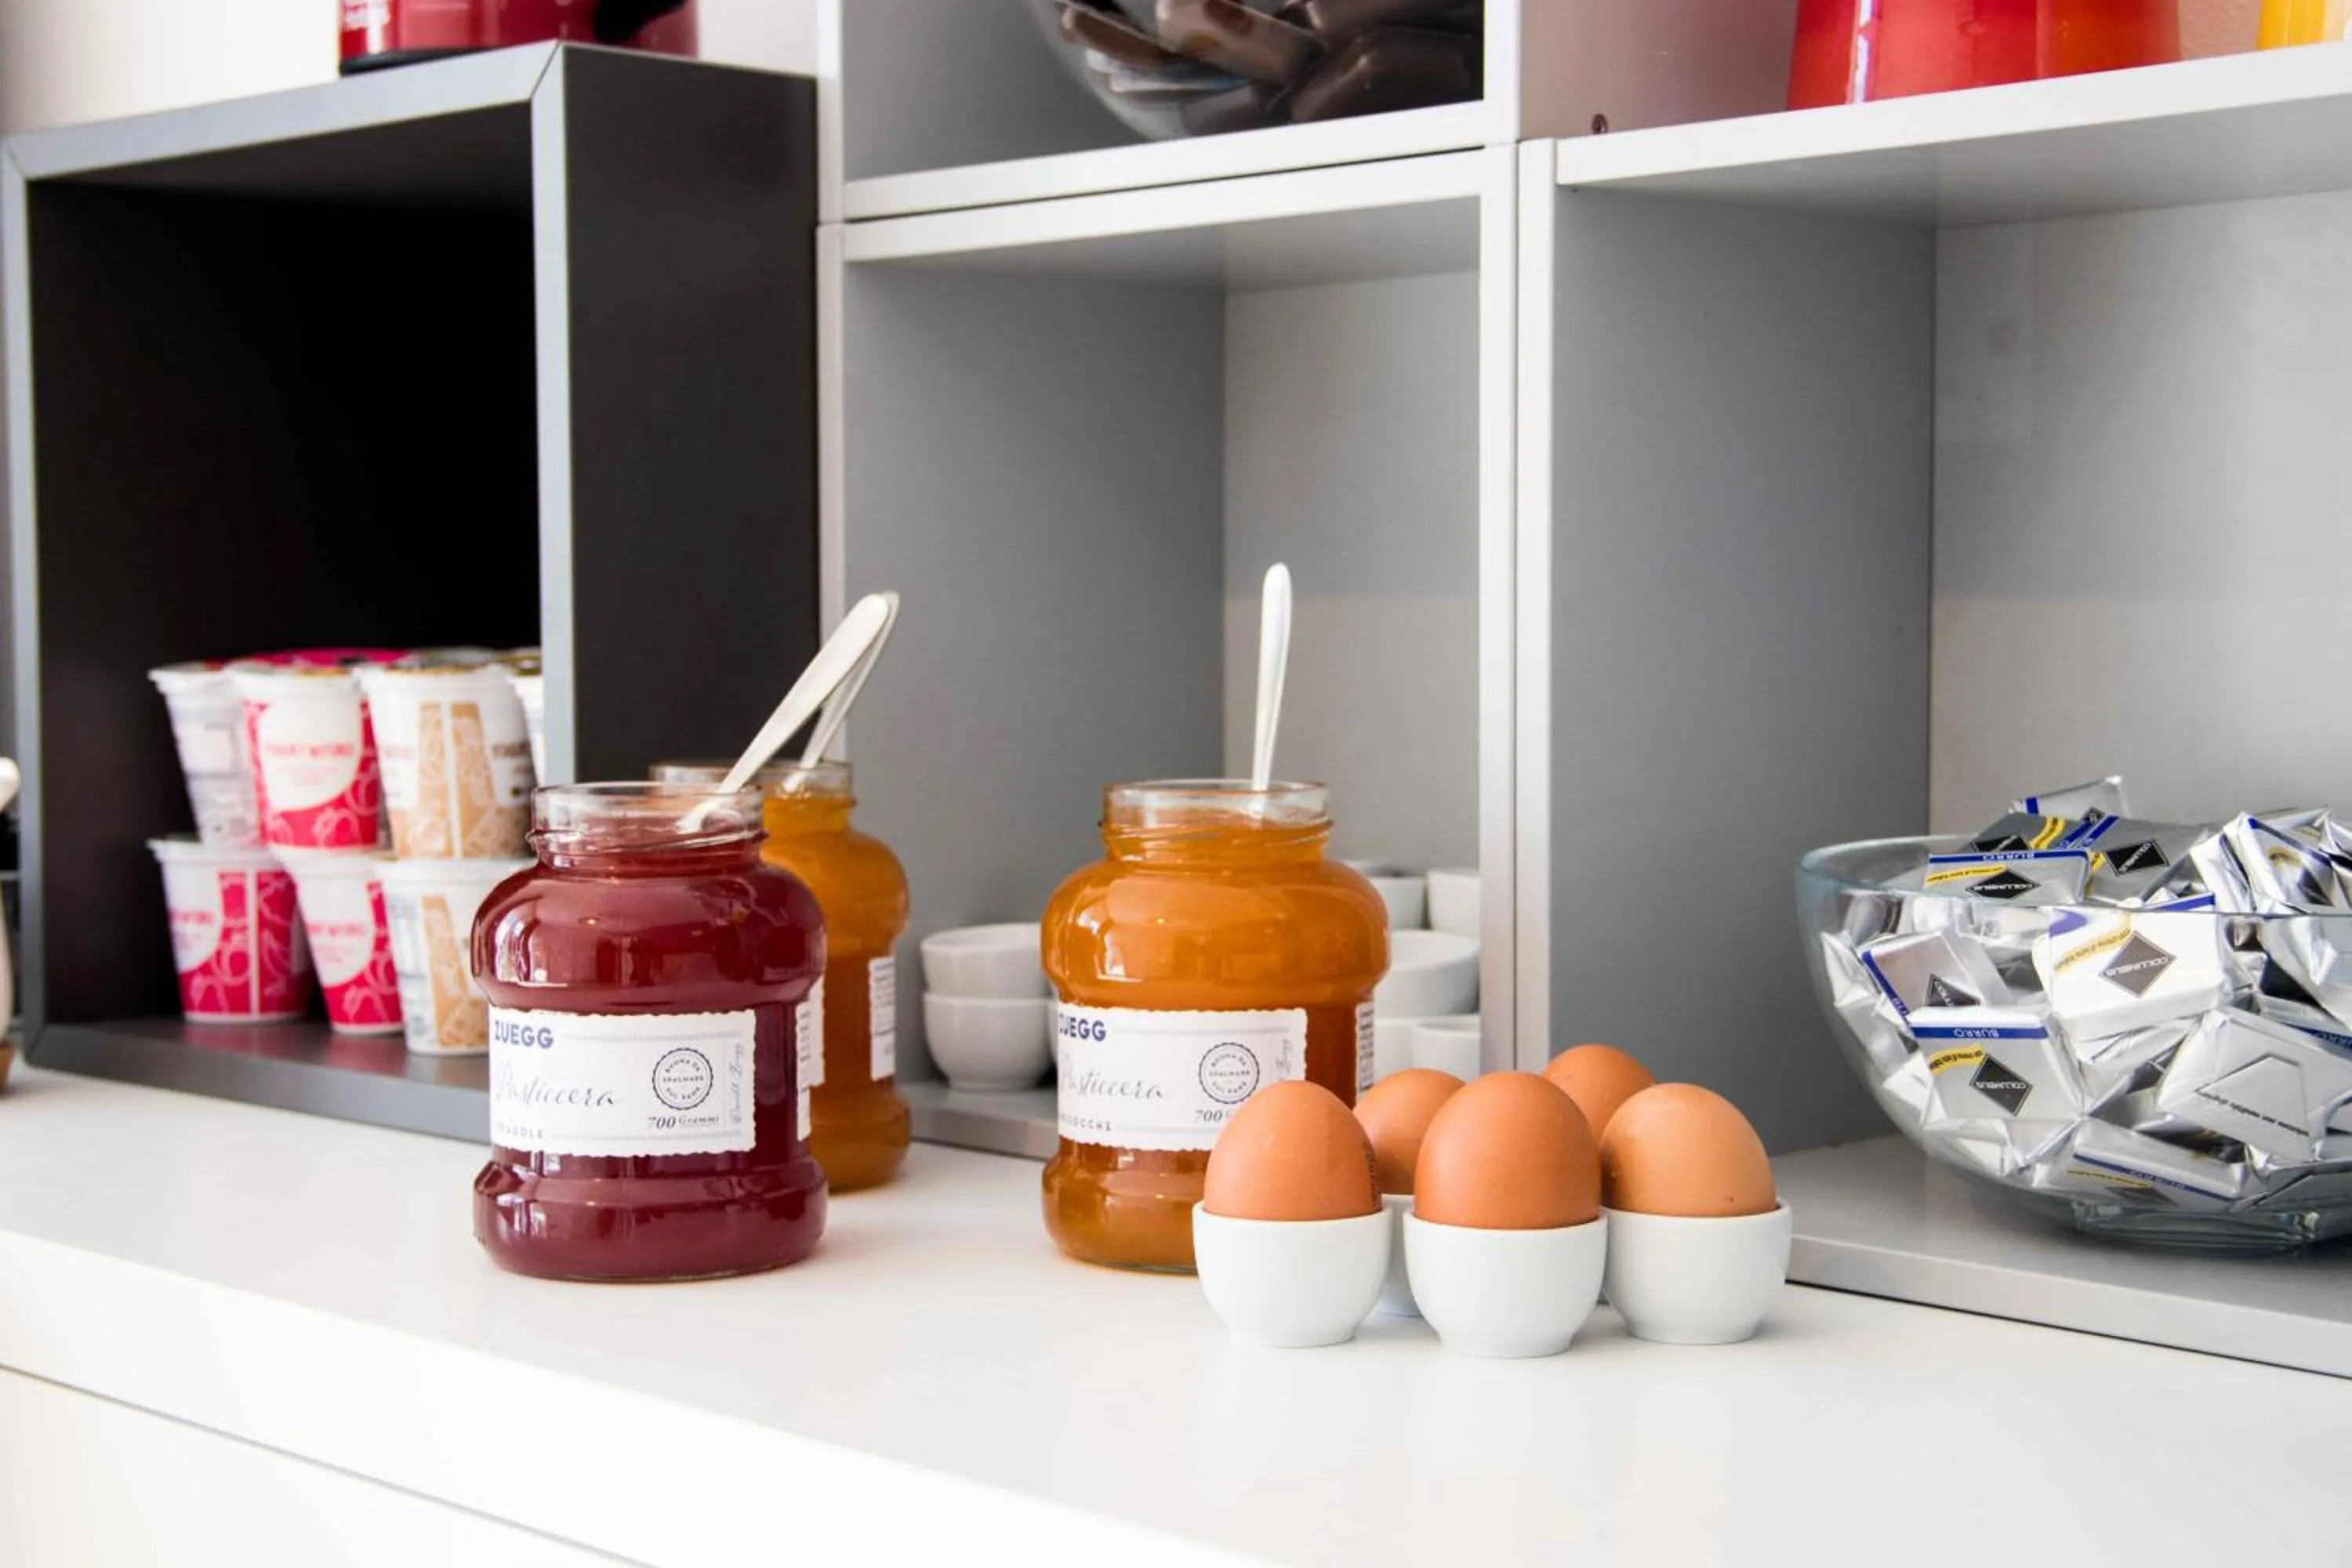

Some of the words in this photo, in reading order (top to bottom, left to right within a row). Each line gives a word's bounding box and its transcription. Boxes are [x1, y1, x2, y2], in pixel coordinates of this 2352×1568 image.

[2105, 955, 2170, 977] COLUMBUS
[494, 1019, 555, 1049] ZUEGG
[1953, 1028, 2000, 1038] BURRO
[495, 1059, 622, 1108] Pasticcera
[646, 1115, 677, 1130] 700
[1193, 1109, 1223, 1123] 700
